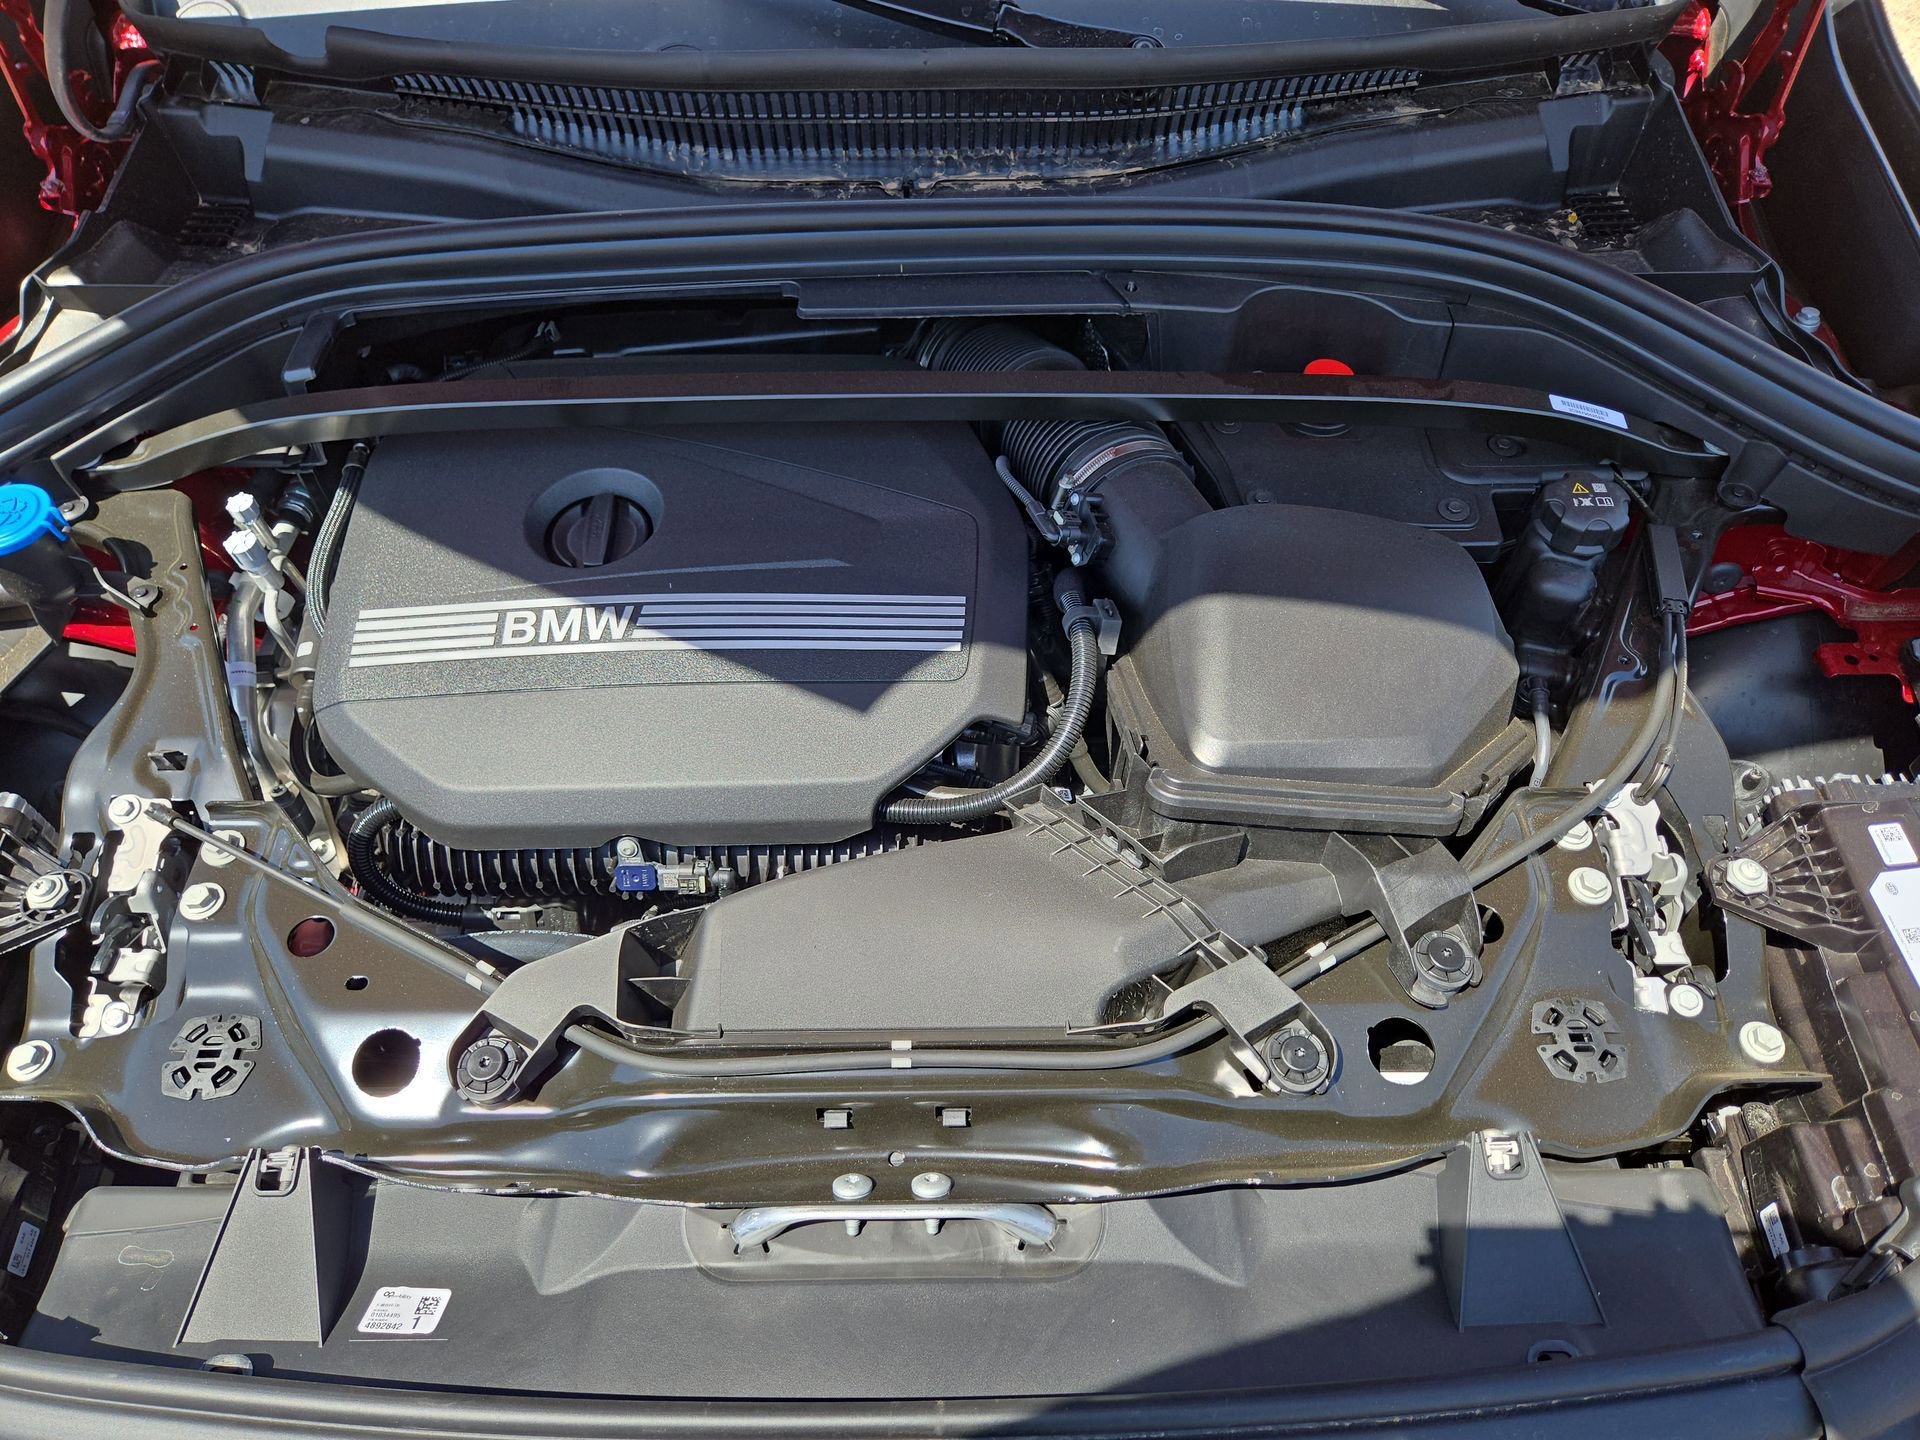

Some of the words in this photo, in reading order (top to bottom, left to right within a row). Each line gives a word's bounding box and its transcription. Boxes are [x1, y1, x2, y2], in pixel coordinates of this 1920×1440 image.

[502, 605, 635, 645] BMW
[365, 1321, 403, 1330] 4892842
[412, 1316, 422, 1329] 1
